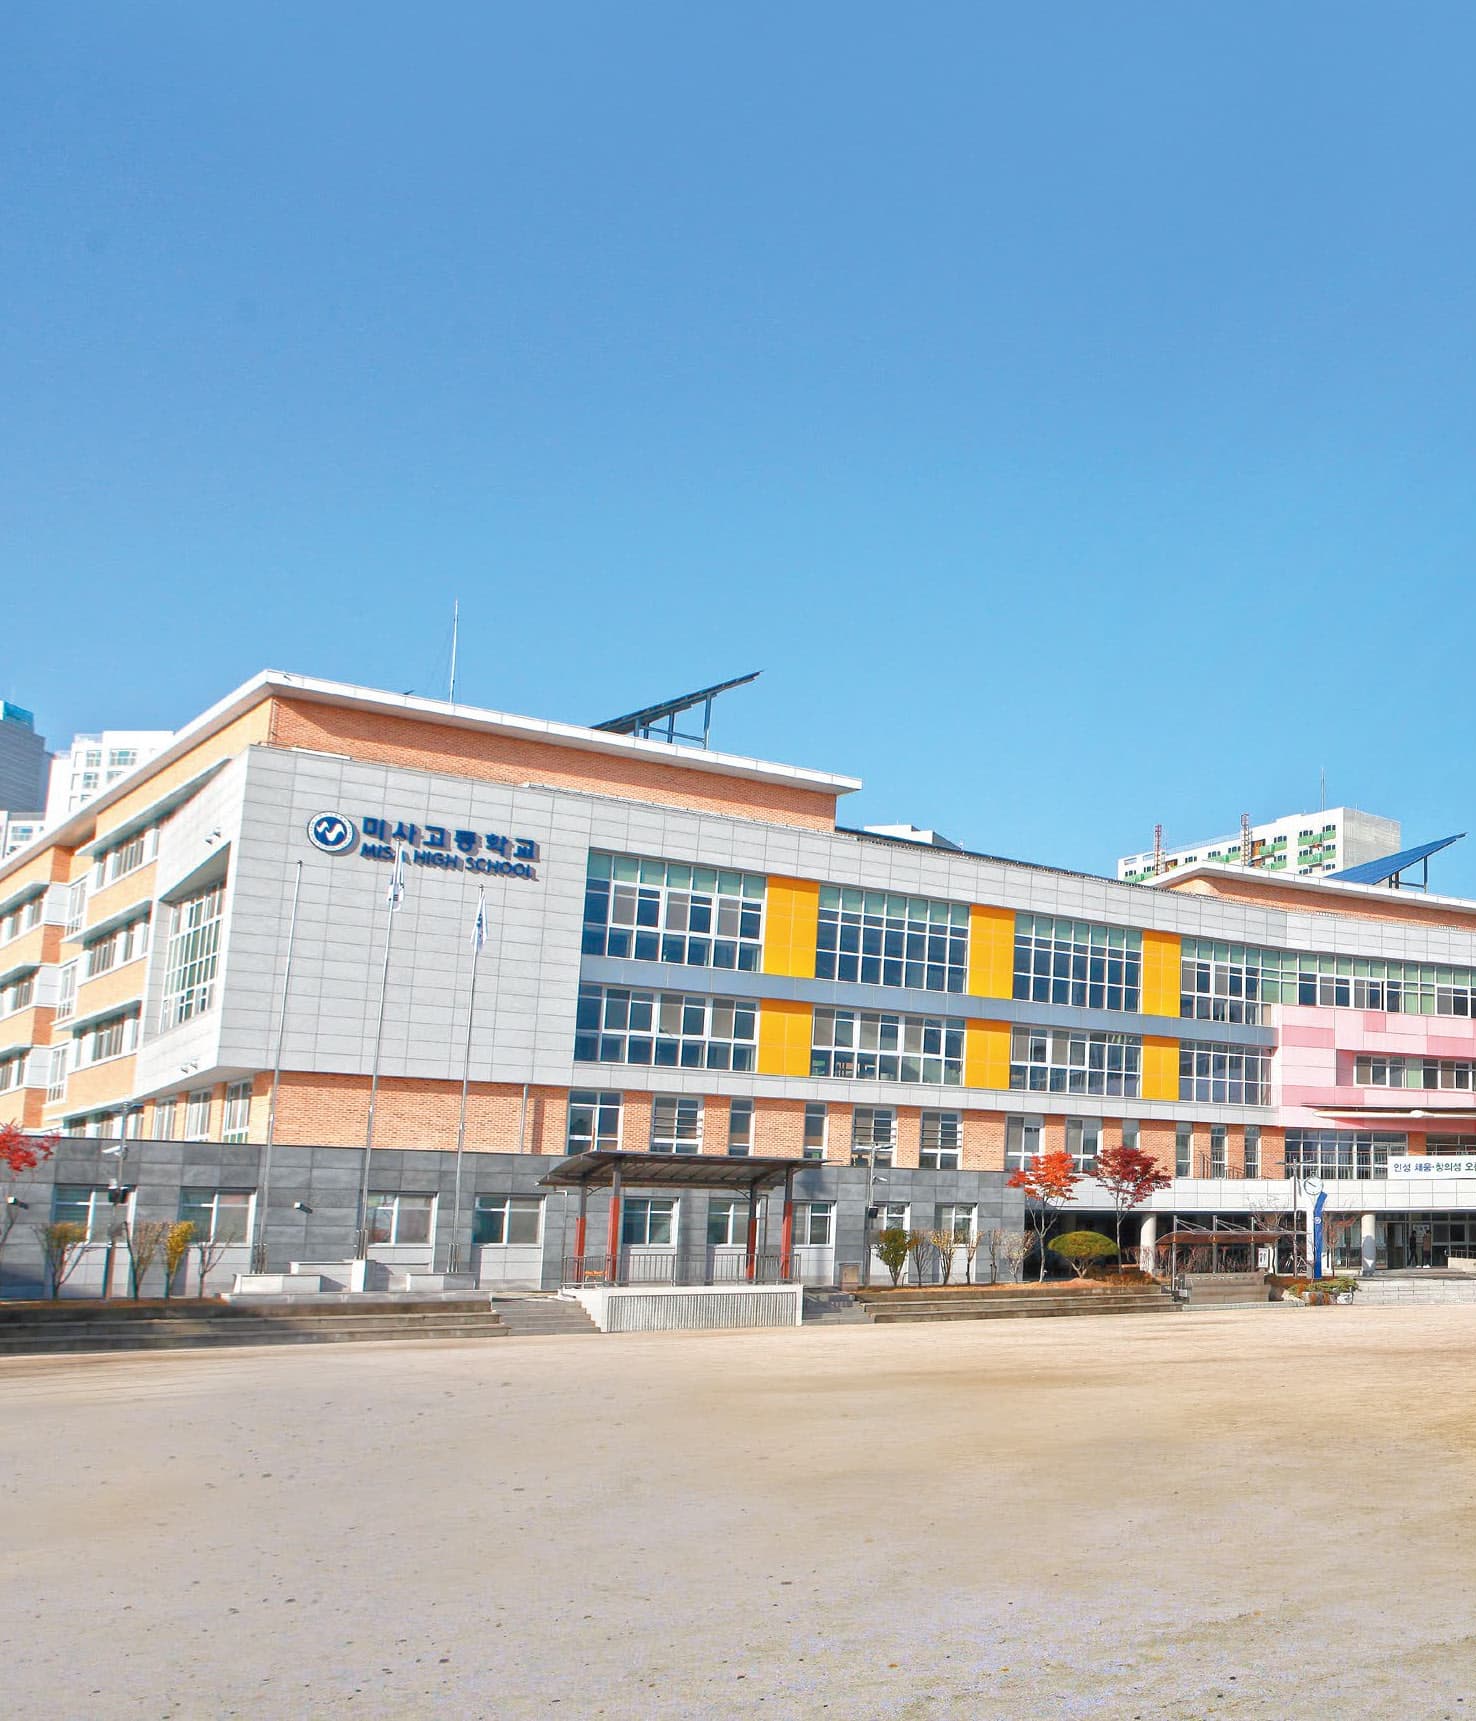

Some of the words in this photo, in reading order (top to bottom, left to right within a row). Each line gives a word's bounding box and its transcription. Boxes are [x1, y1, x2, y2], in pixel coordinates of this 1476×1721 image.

[361, 816, 536, 860] 미사고등학교
[413, 849, 458, 868] HIGH
[465, 857, 533, 878] SCHOOL
[1393, 1163, 1411, 1172] 인성
